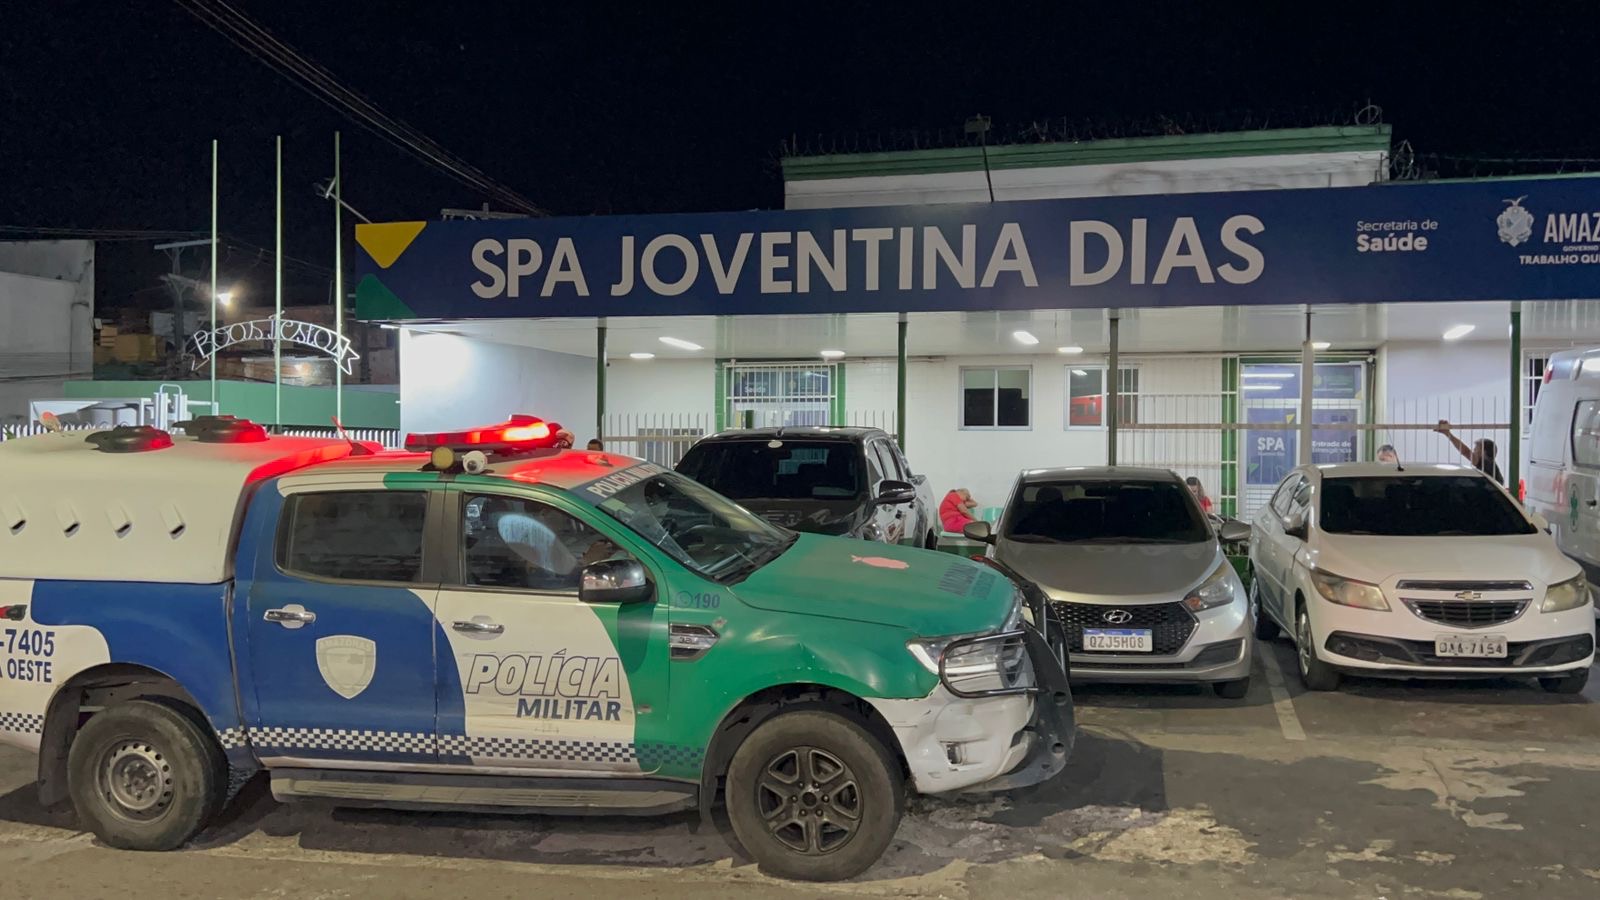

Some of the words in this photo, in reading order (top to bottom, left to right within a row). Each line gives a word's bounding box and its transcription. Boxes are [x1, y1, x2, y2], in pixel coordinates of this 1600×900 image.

[1357, 221, 1417, 231] Secretaria
[1421, 219, 1438, 230] de
[1357, 232, 1428, 252] Saúde
[471, 238, 590, 299] SPA
[610, 222, 1039, 298] JOVENTINA
[1069, 214, 1266, 288] DIAS
[1519, 255, 1578, 264] TRABALHO
[1581, 254, 1600, 264] QU
[1257, 437, 1285, 451] SPA
[694, 593, 720, 608] 190
[1089, 636, 1144, 648] QZJ5H08
[7, 658, 52, 683] OESTE
[466, 648, 620, 698] POLÍCIA
[516, 698, 621, 721] MILITAR
